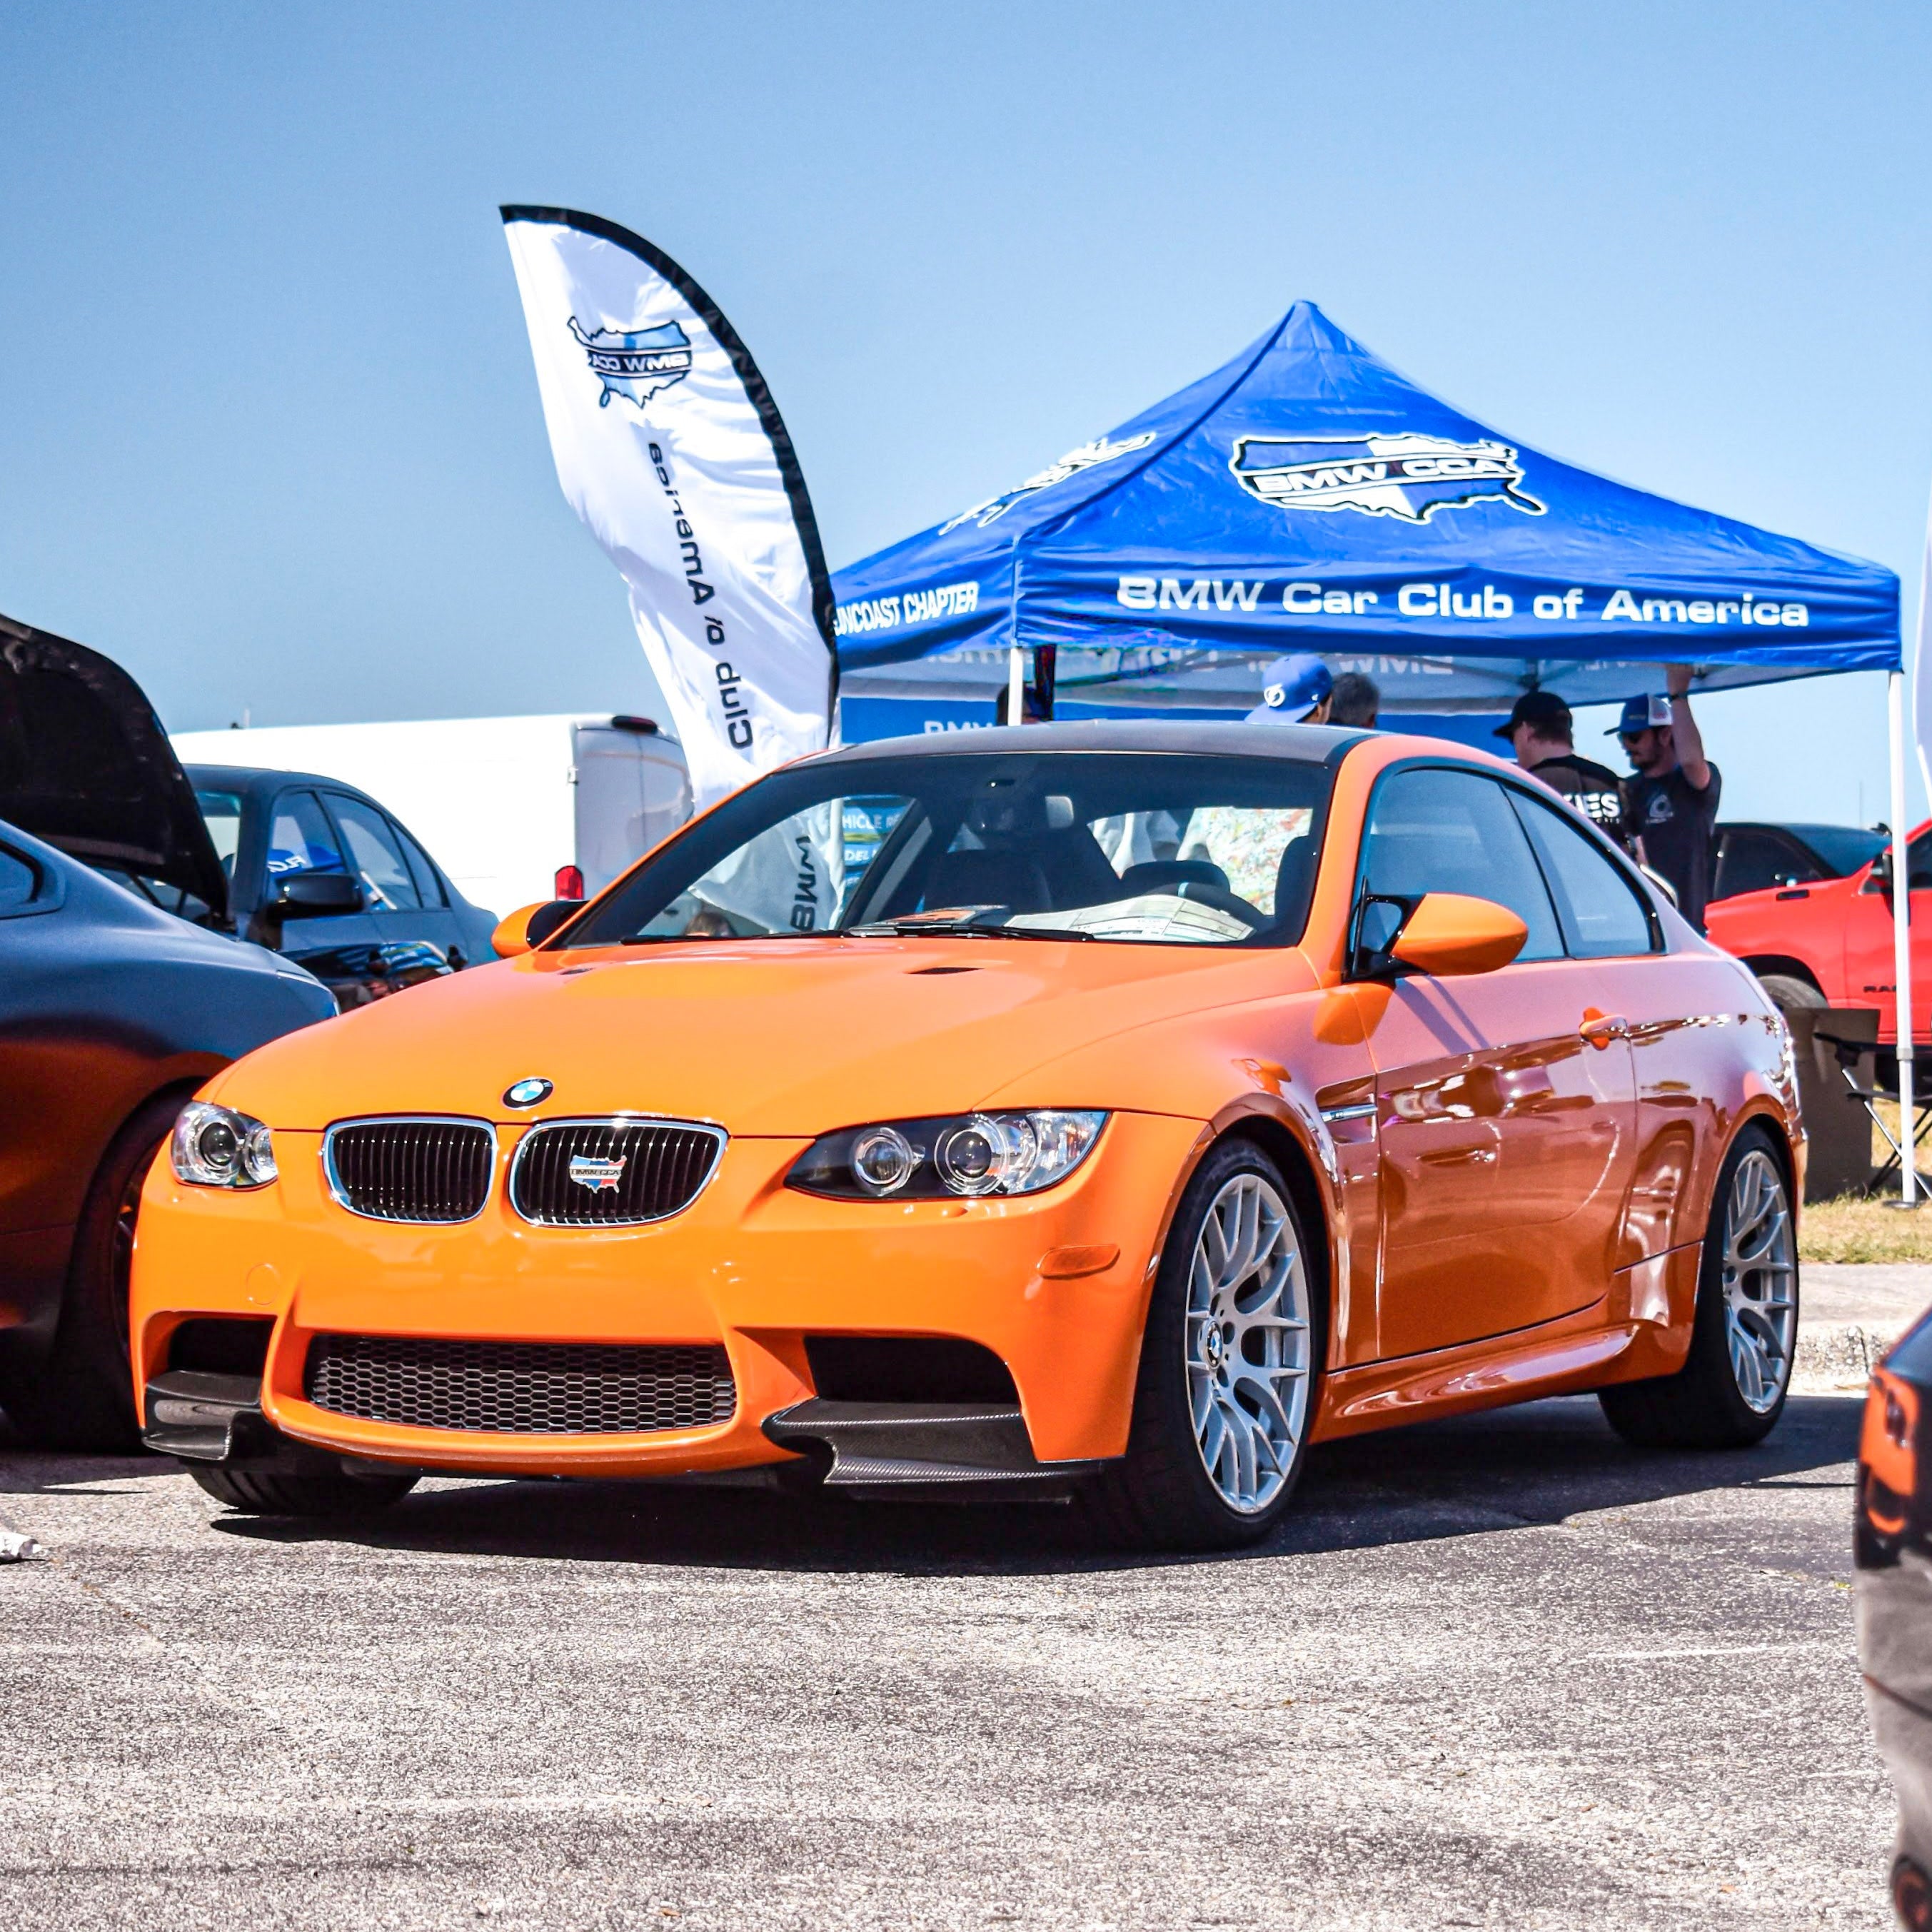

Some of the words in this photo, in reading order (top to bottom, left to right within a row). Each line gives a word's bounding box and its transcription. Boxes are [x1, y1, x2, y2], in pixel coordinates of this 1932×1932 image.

[1253, 463, 1386, 493] BMW
[1402, 458, 1510, 476] CCA
[833, 596, 900, 636] UNCOAST
[903, 580, 980, 625] CHAPTER
[1117, 576, 1264, 612] BMW
[1283, 582, 1378, 615] Car
[1397, 584, 1514, 619] Club
[1532, 588, 1584, 620] of
[1600, 589, 1809, 627] America
